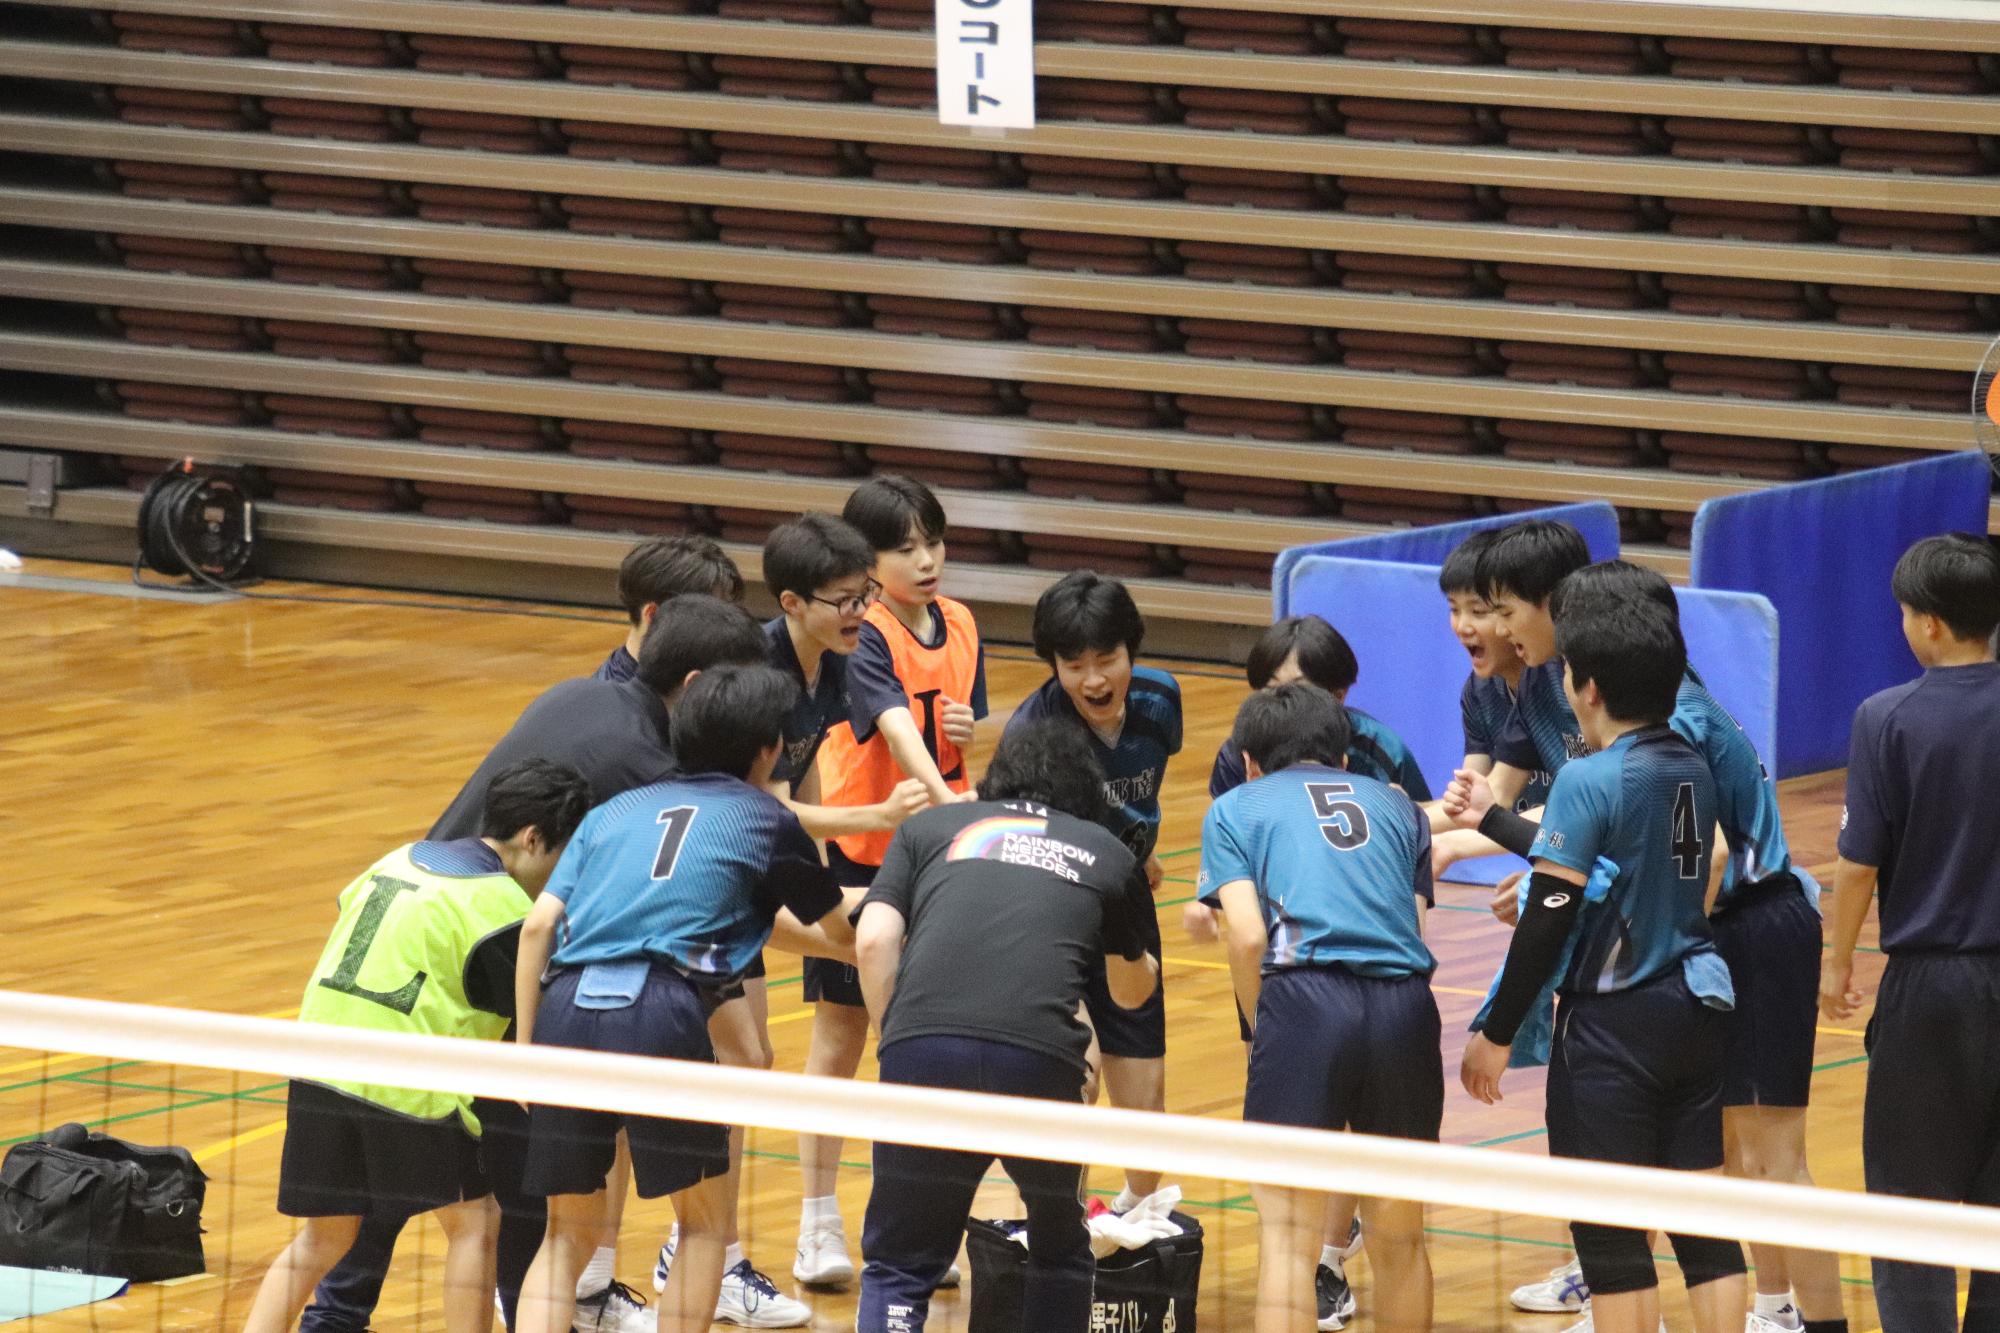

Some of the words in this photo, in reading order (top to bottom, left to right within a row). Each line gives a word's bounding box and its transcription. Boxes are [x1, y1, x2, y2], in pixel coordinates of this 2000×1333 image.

[959, 0, 1001, 114] コート
[650, 804, 699, 881] 1
[1002, 840, 1068, 866] MEDAL
[1003, 832, 1096, 867] RAINBOW
[1304, 782, 1370, 851] 5
[1671, 782, 1702, 880] 4
[1000, 851, 1081, 883] HOLDER
[319, 874, 427, 1016] L
